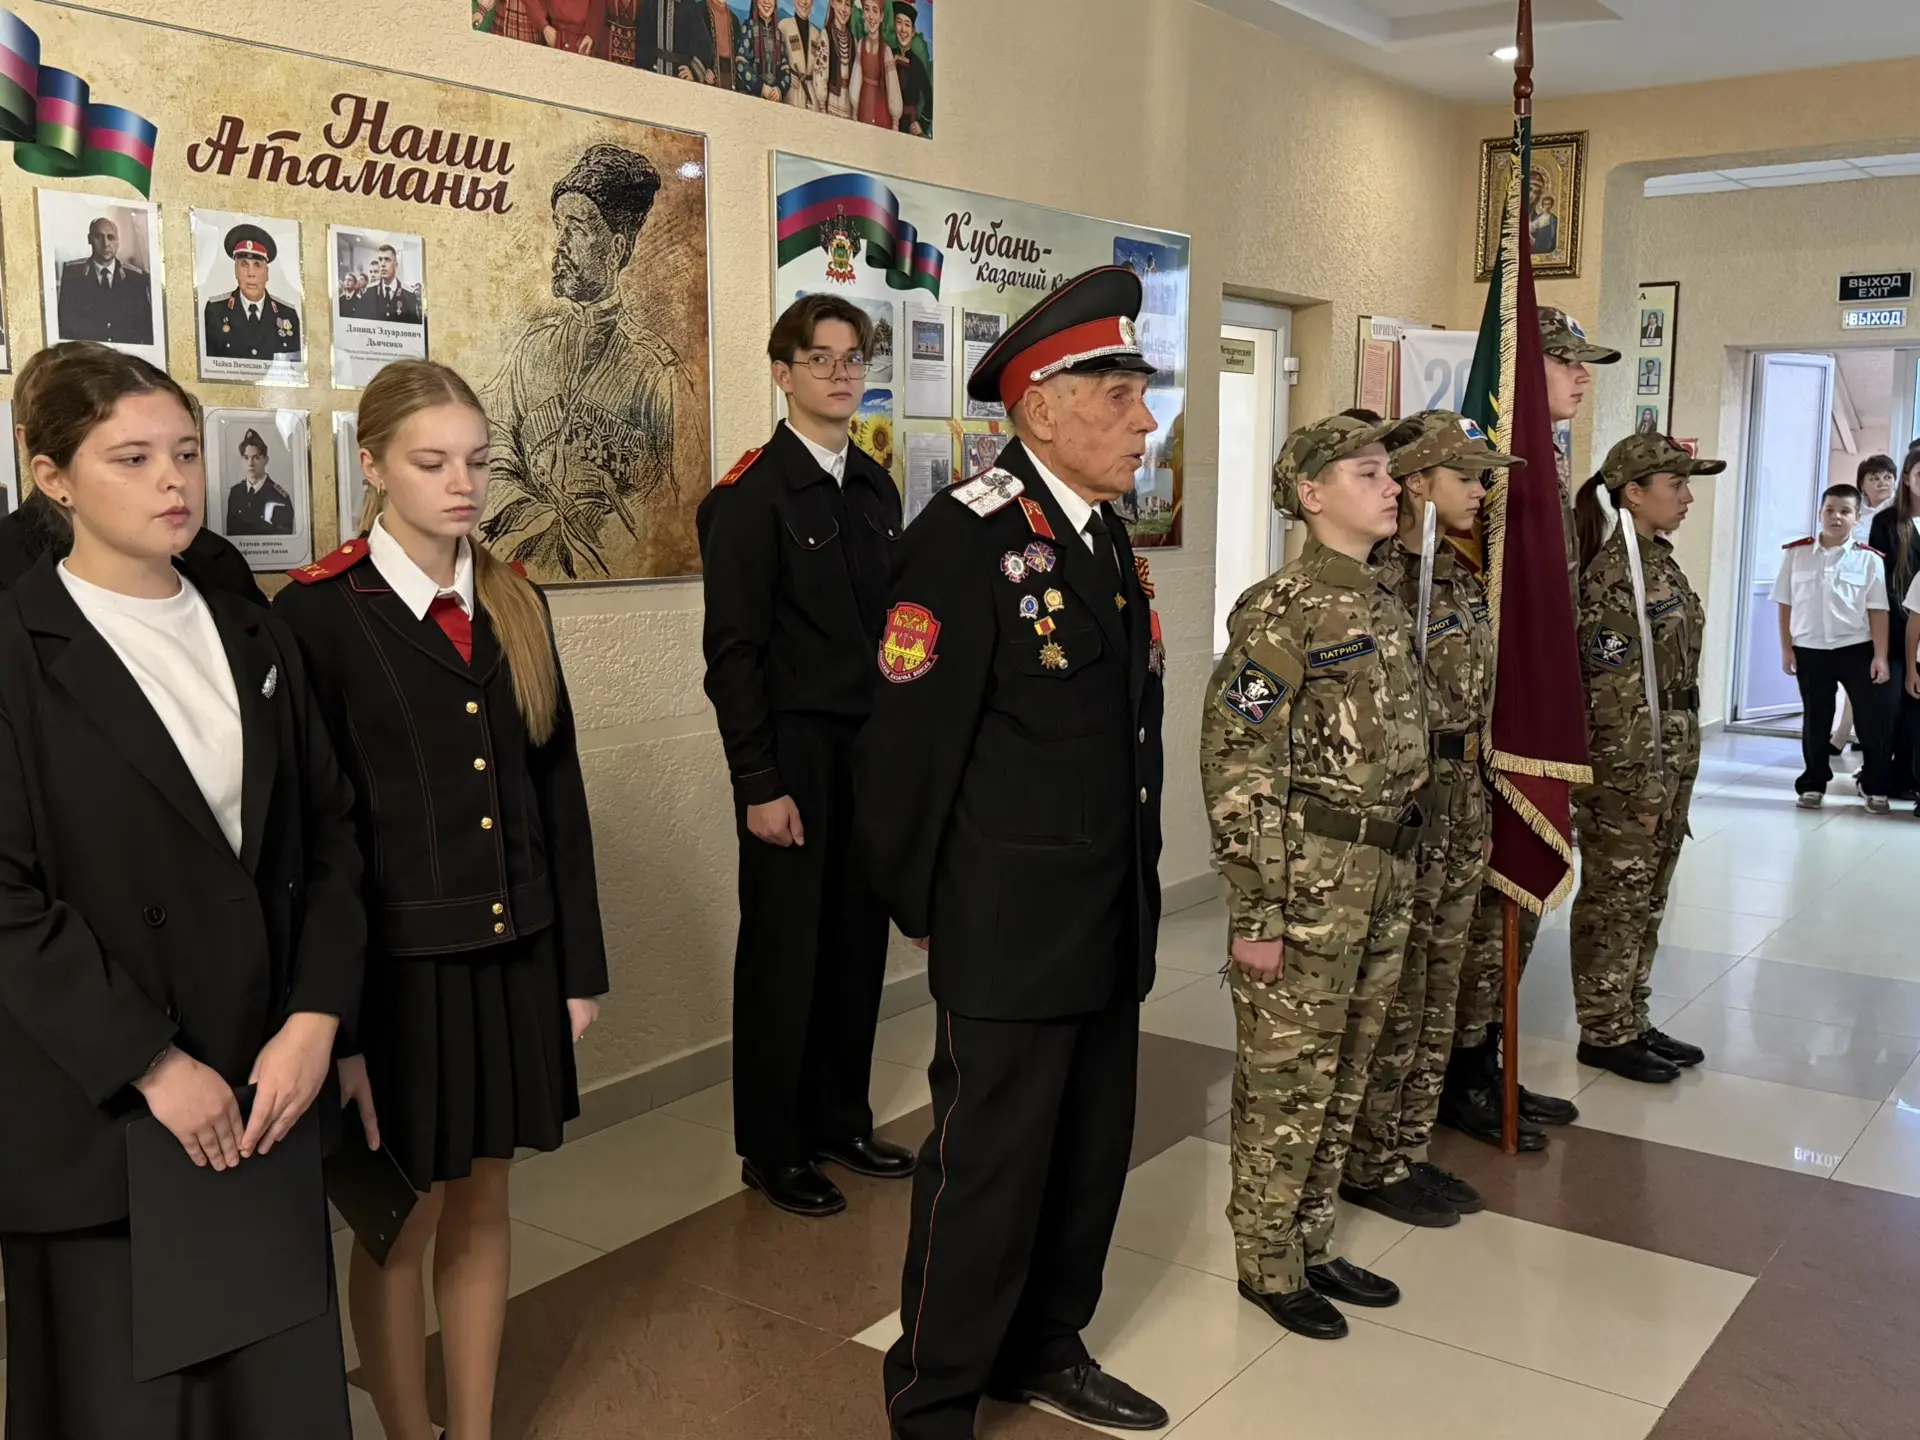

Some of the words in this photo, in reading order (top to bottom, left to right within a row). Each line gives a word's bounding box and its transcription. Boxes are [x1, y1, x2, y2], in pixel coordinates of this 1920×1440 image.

[323, 92, 515, 176] Наши
[187, 115, 514, 214] Атаманы
[945, 211, 1052, 264] Кубань-
[1848, 275, 1902, 288] ВЫХОД
[1858, 287, 1891, 298] EXIT
[1848, 311, 1902, 326] ВЫХОД
[1427, 618, 1451, 634] РИОТ
[1319, 642, 1365, 661] ПАТРИОТ
